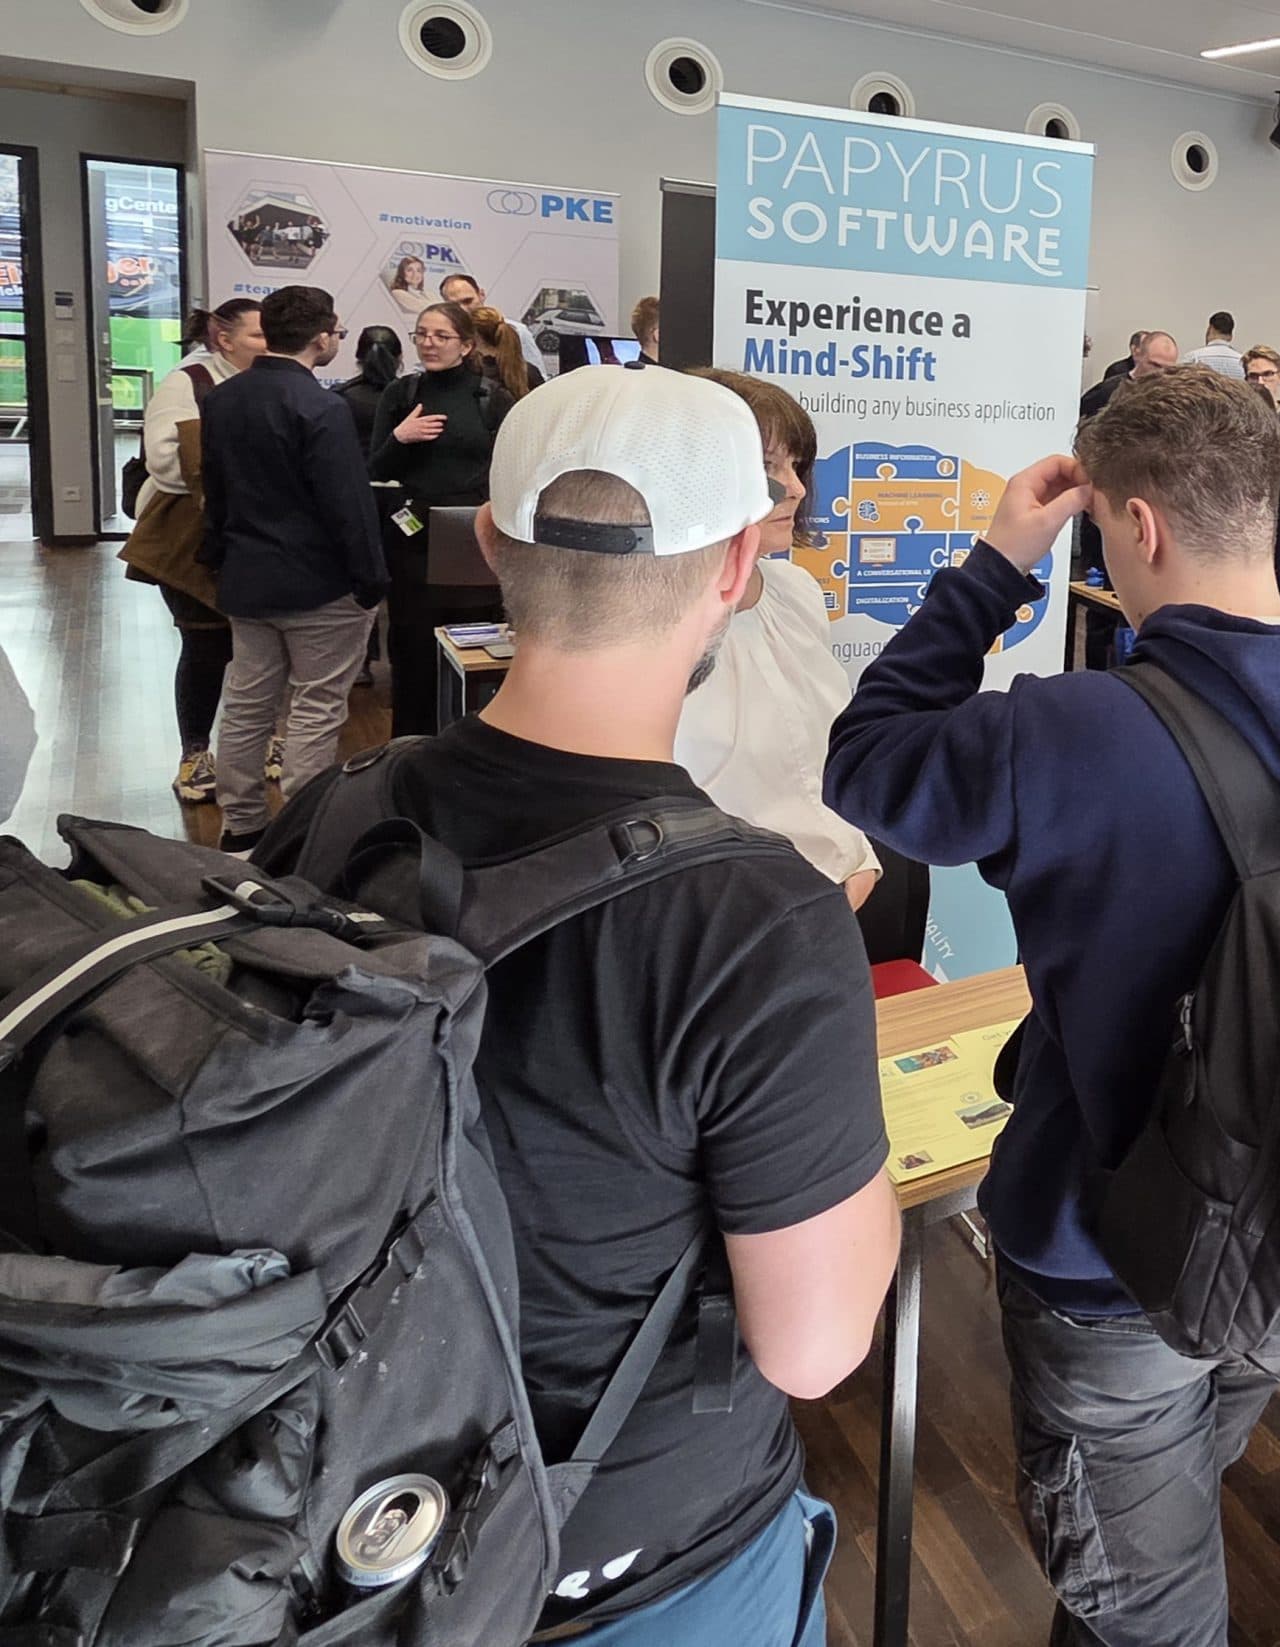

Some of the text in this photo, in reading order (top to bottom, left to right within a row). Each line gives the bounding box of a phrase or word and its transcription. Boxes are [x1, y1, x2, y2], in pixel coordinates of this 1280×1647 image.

[747, 124, 1063, 219] PAPYRUS
[379, 212, 472, 230] #motivation
[541, 195, 613, 224] PKE
[746, 197, 1063, 277] SOFTWARE
[745, 289, 971, 338] Experience a
[743, 337, 937, 382] Mind-Shift
[799, 391, 1055, 423] building any business application
